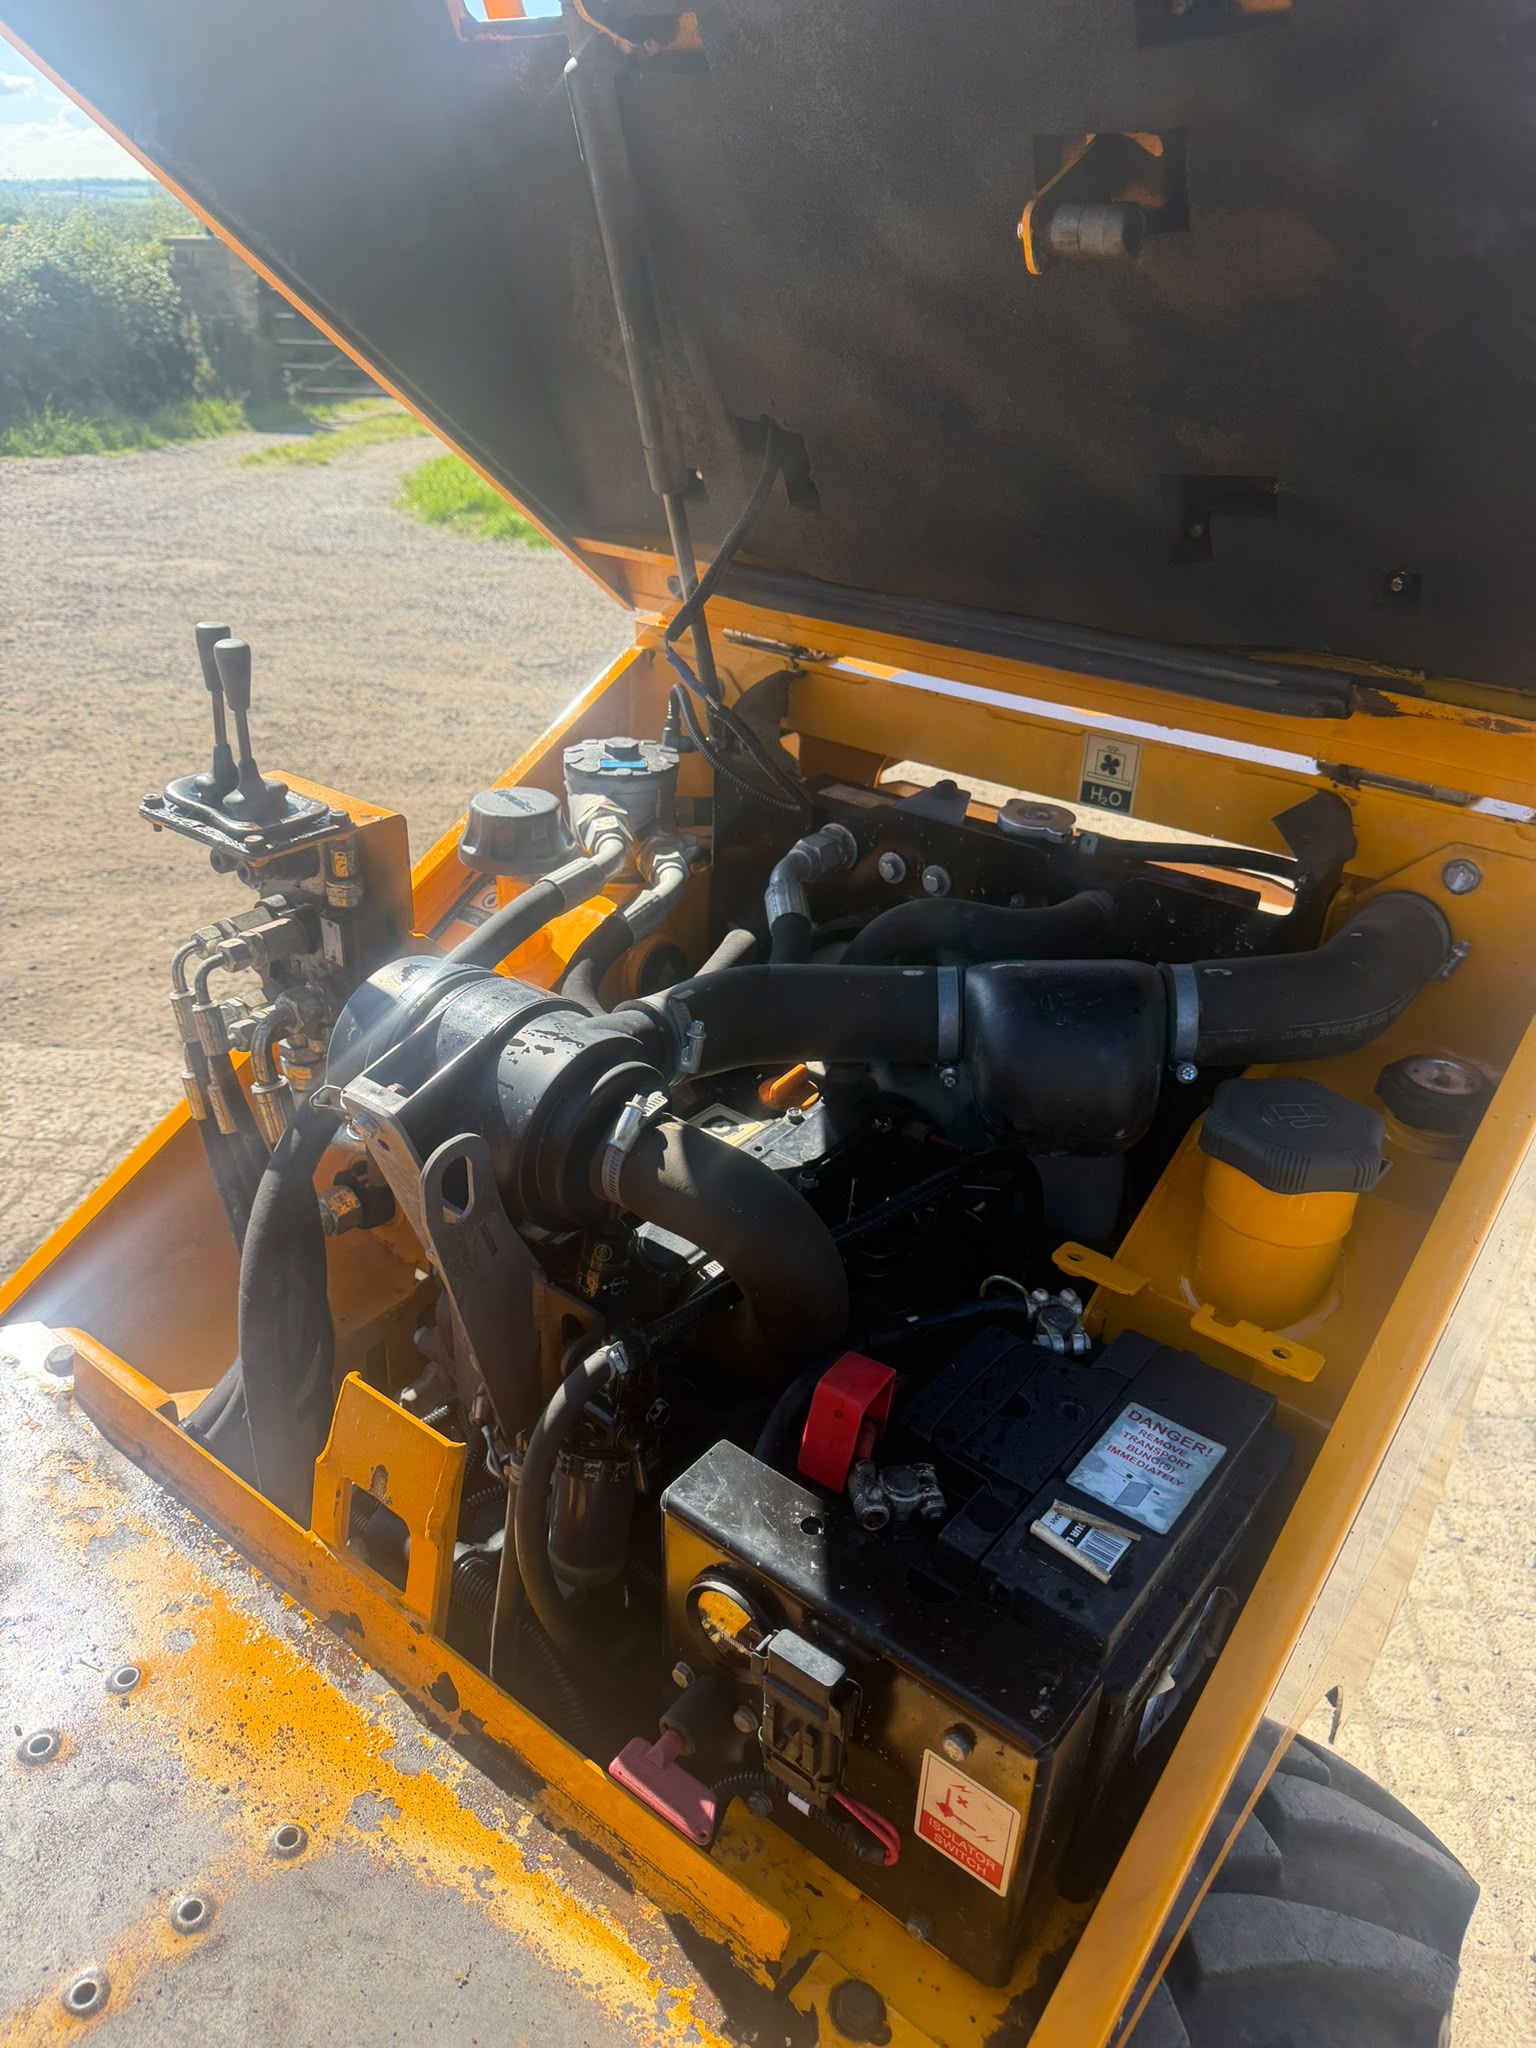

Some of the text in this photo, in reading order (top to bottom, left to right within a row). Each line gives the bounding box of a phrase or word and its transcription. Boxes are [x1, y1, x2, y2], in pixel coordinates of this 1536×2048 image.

[1123, 1430, 1193, 1470] TRANSPORT
[1128, 1410, 1213, 1457] DANGER!
[1138, 1429, 1188, 1458] REMOVE
[1107, 1445, 1185, 1486] IMMEDIATELY
[1125, 1444, 1176, 1474] BUNG(S)
[928, 1817, 996, 1872] ISOLATOR
[934, 1833, 986, 1876] SWITCH
